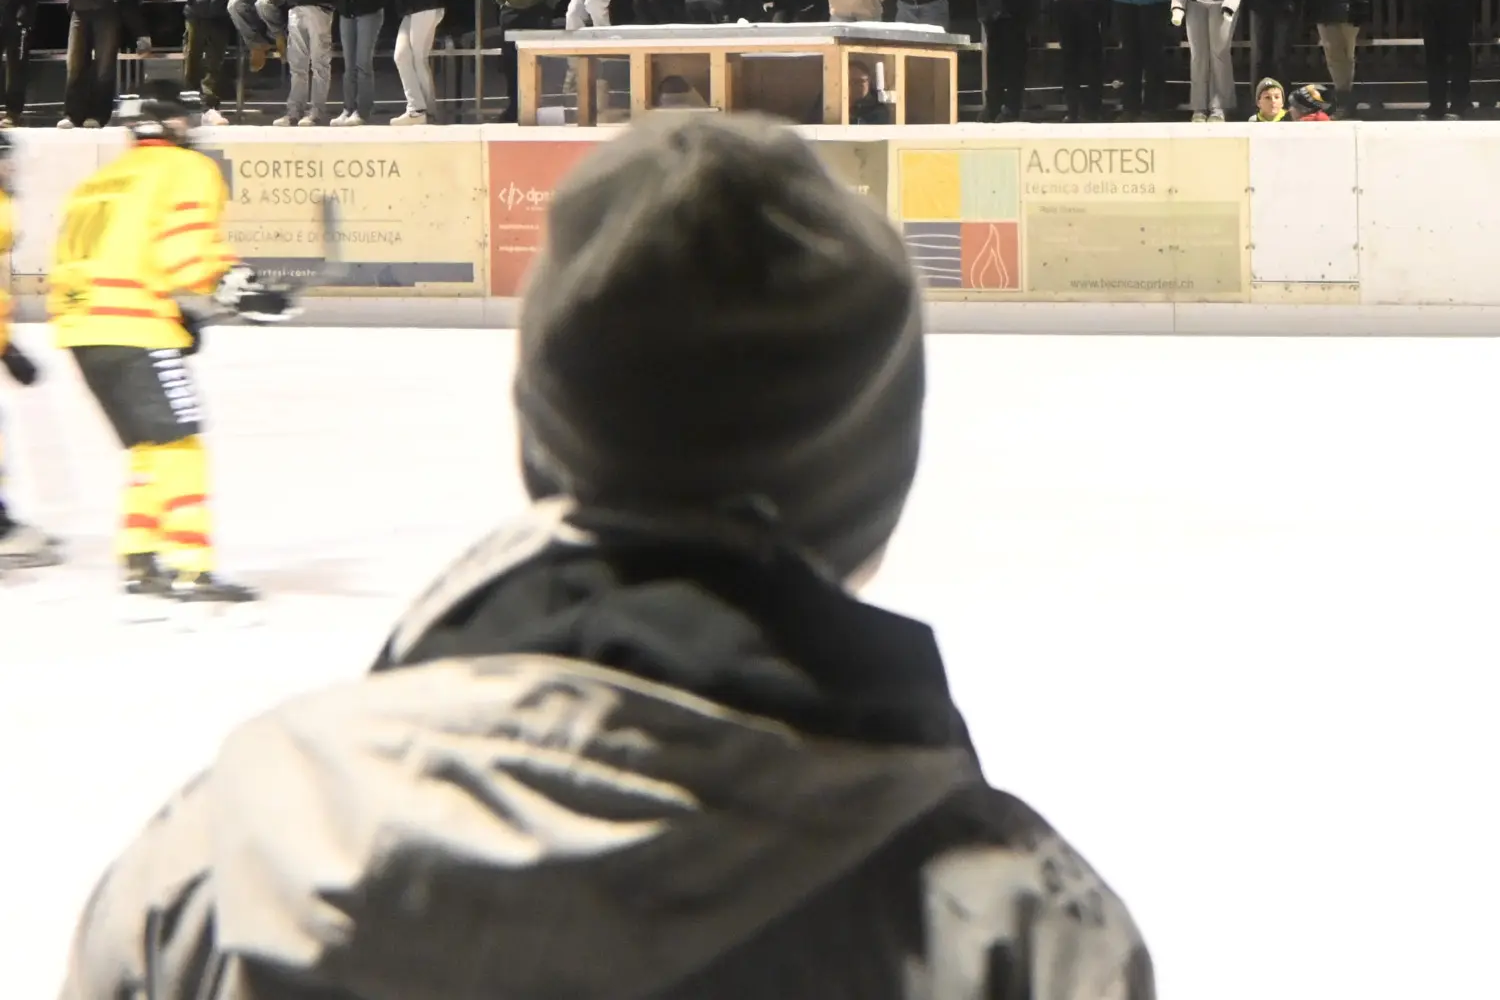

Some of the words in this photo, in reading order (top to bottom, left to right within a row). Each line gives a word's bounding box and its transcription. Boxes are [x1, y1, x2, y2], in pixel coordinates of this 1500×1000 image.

[240, 160, 323, 178] CORTESI
[333, 160, 401, 178] COSTA
[240, 189, 251, 205] &
[260, 188, 355, 205] ASSOCIATI
[1025, 181, 1080, 195] tecnica
[1084, 181, 1118, 195] della
[1122, 184, 1156, 195] casa
